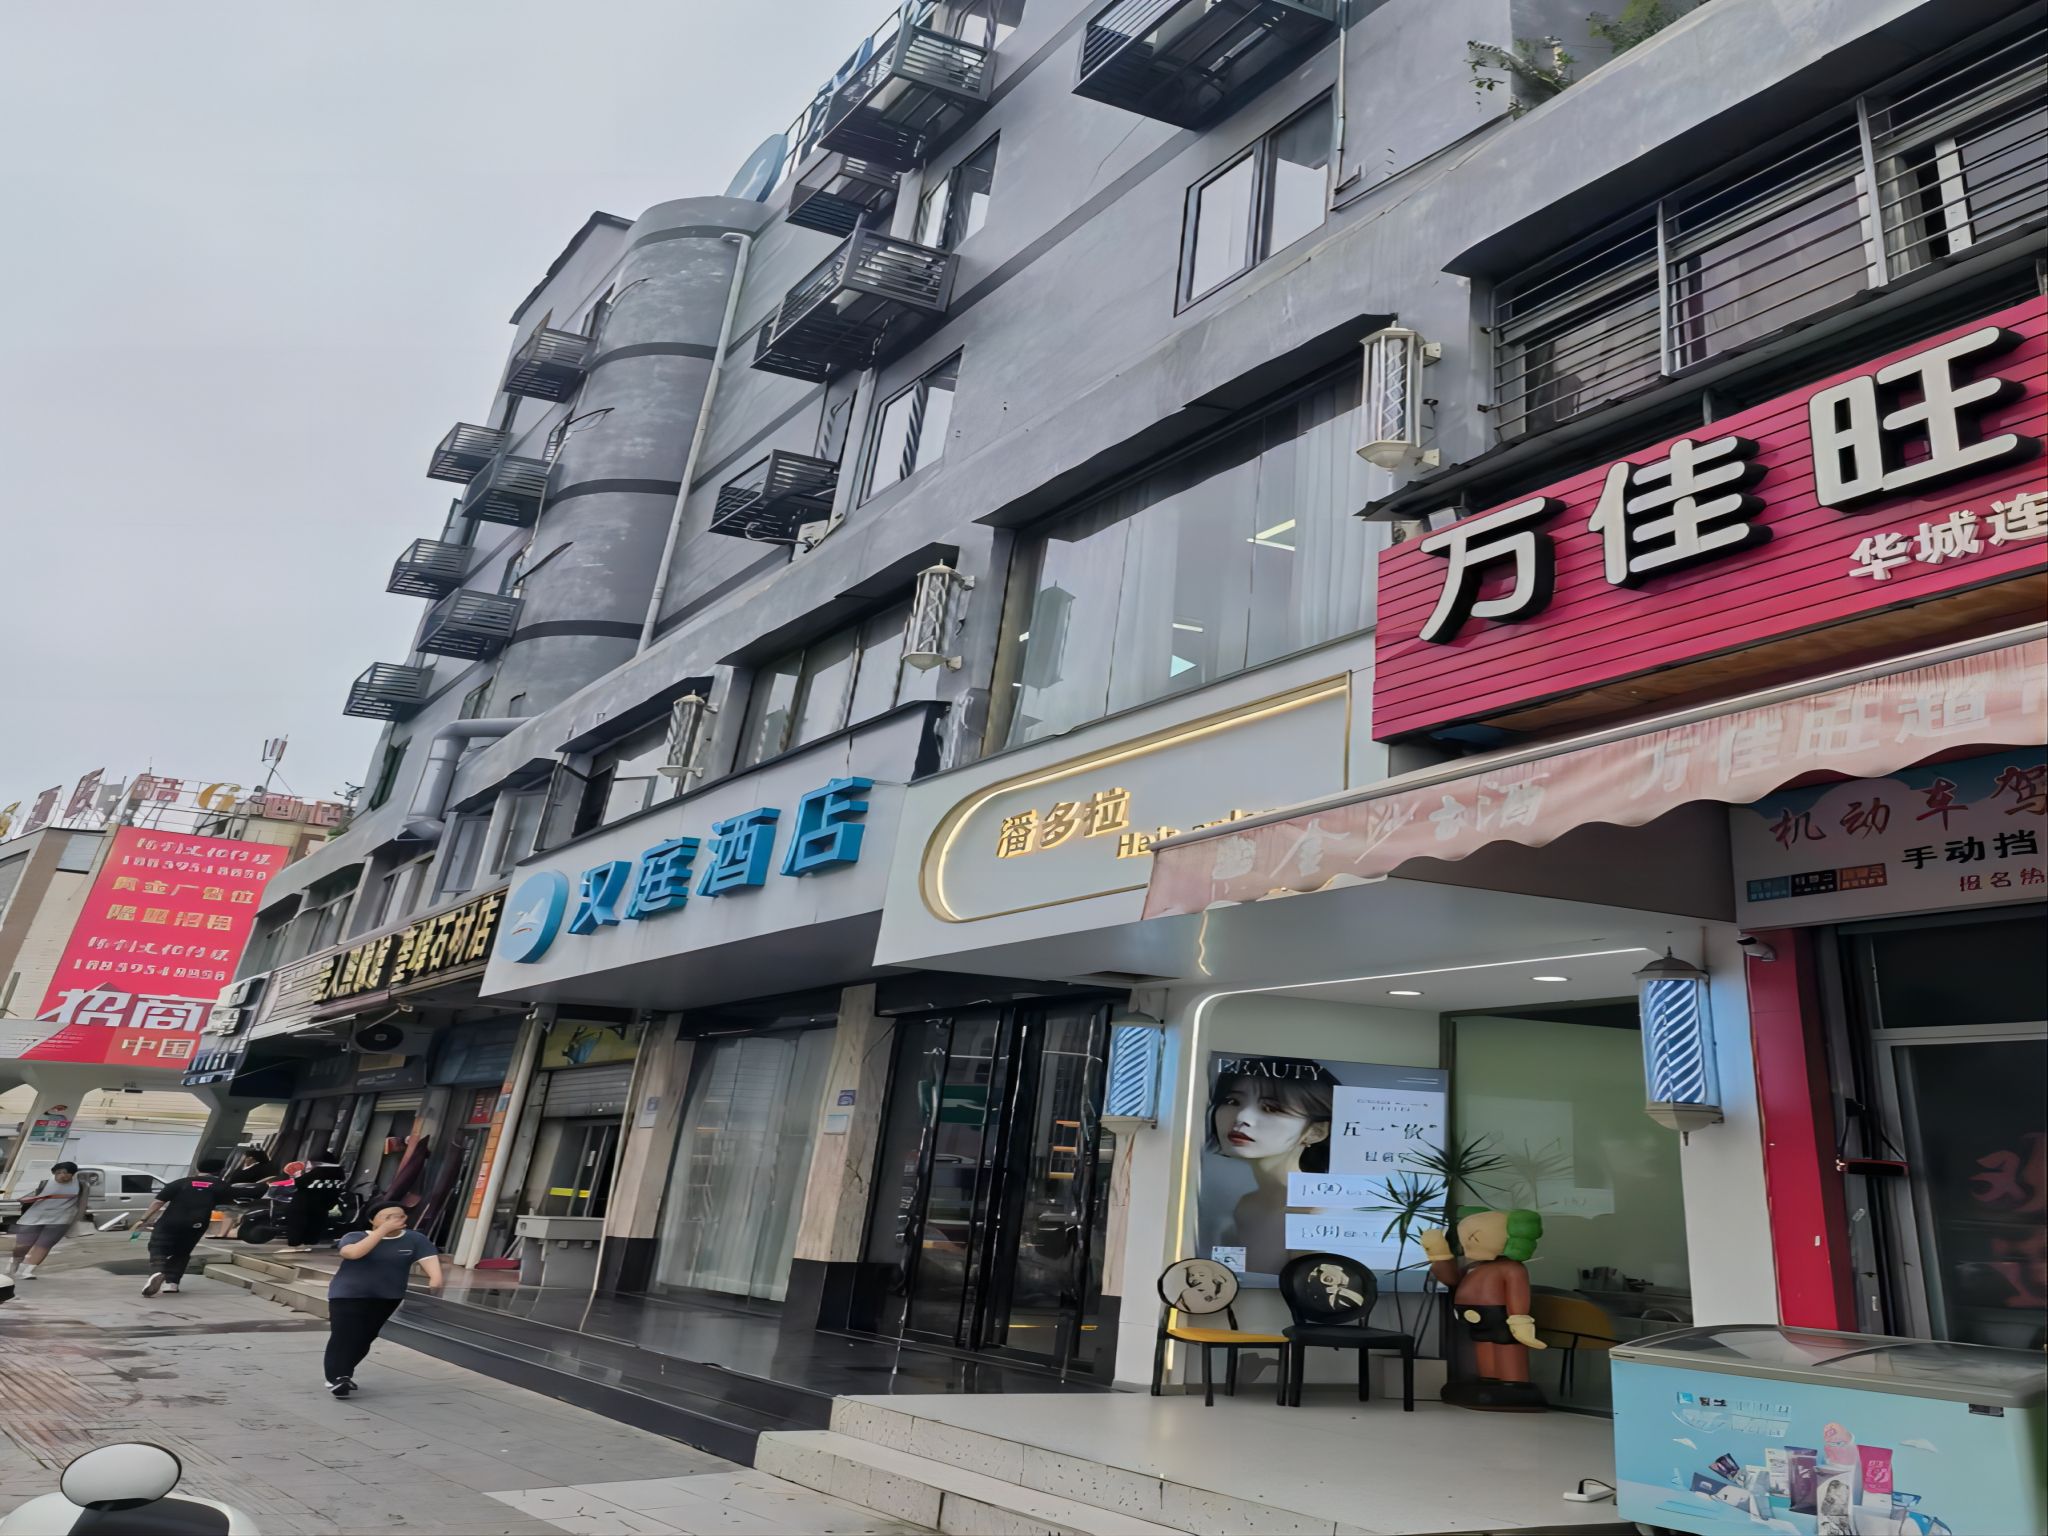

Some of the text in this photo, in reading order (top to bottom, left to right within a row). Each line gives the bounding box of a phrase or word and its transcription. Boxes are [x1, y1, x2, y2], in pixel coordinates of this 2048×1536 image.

[1419, 325, 2032, 643] 万佳旺
[1849, 491, 2047, 581] 华城连
[996, 787, 1132, 859] 潘多拉
[1901, 829, 2039, 869] 手动挡
[567, 776, 873, 936] 汉庭酒店
[37, 987, 215, 1032] 招商
[121, 1035, 196, 1060] 中国
[1217, 1058, 1324, 1081] BEAUTY
